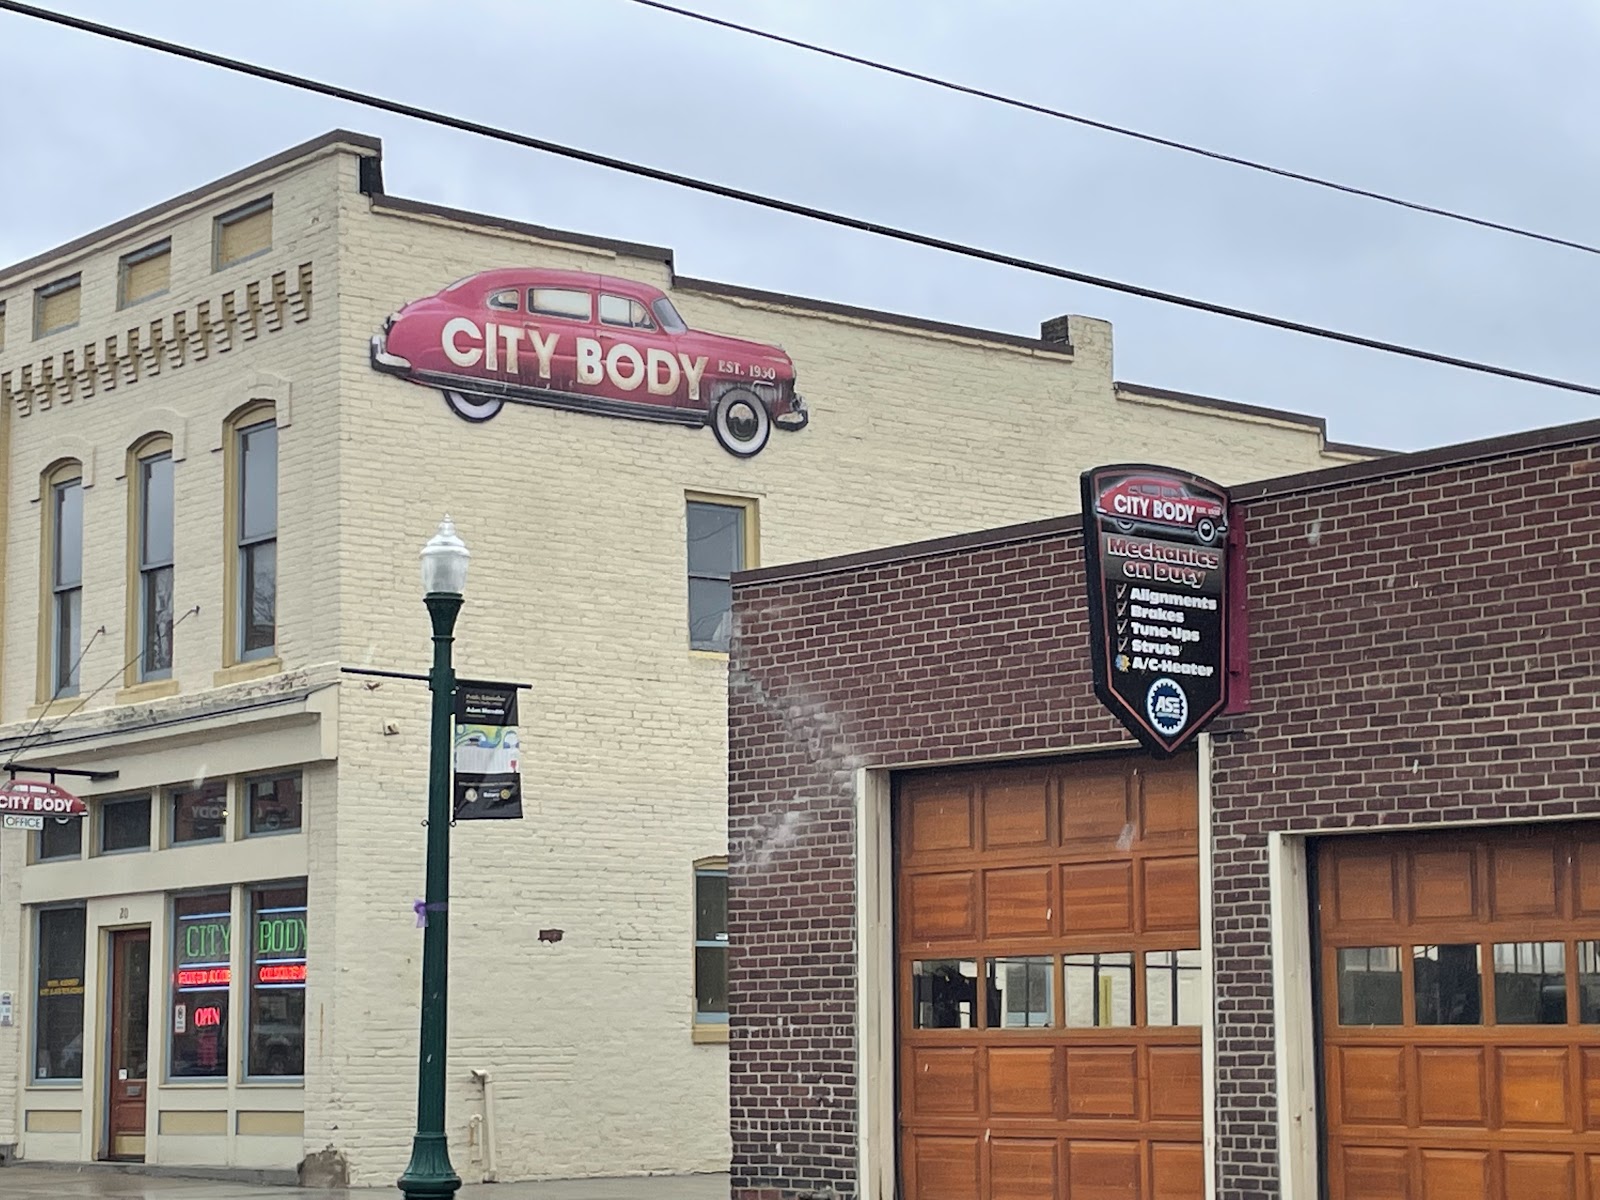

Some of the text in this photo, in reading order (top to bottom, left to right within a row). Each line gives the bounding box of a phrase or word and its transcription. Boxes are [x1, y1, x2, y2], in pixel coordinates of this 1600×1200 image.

[441, 317, 709, 401] CITY BODY
[718, 359, 776, 380] EST. 1930
[1114, 494, 1197, 524] CITY BODY
[1107, 538, 1219, 570] Mechanics
[1123, 561, 1207, 589] on Duty
[1130, 587, 1218, 611] Alignments
[1130, 604, 1185, 624] Brakes
[1131, 621, 1201, 643] Tune-Ups
[1131, 639, 1181, 657] Struts
[1132, 656, 1214, 678] A/C-Heater
[1155, 695, 1182, 713] ASE
[0, 795, 74, 813] CITY BODY
[5, 816, 41, 829] OFFICE
[119, 907, 129, 920] 20
[186, 923, 231, 958] CITY
[195, 1006, 220, 1027] OPEN
